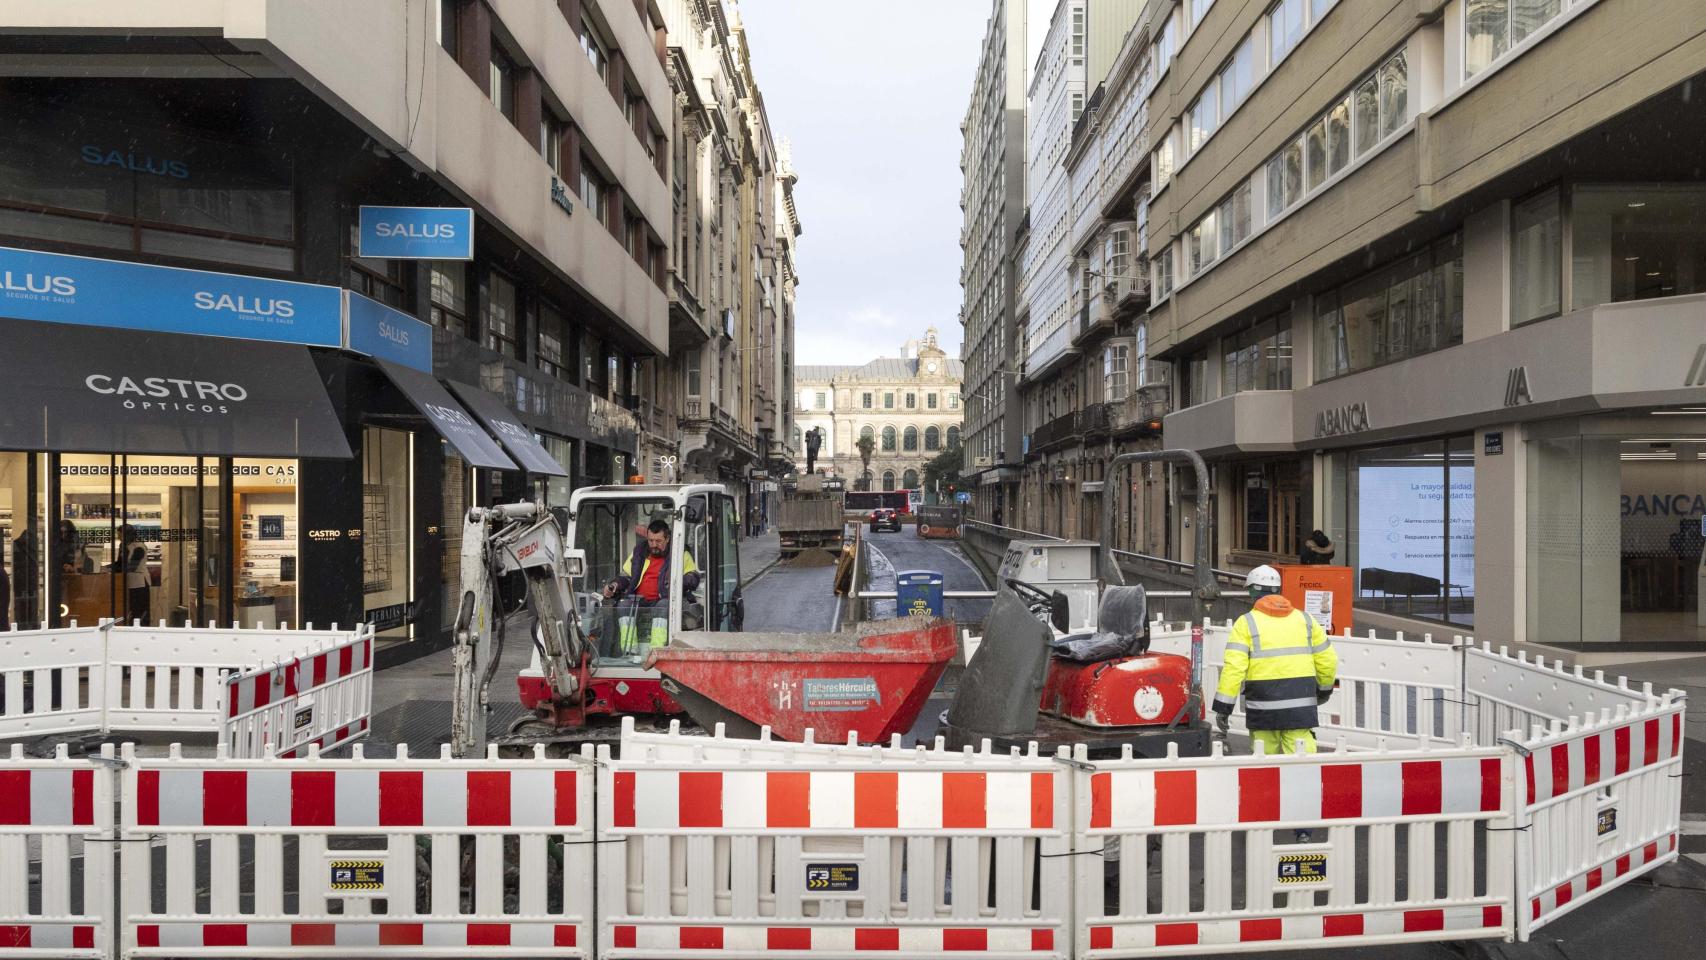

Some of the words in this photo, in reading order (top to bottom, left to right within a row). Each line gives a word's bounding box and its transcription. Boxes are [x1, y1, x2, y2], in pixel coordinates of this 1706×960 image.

[81, 145, 190, 178] SALUS
[375, 222, 456, 238] SALUS
[194, 291, 295, 317] SALUS
[378, 321, 409, 346] SALUS
[85, 374, 247, 401] CASTRO
[123, 399, 228, 413] ÓPTICOS
[808, 870, 829, 879] F3
